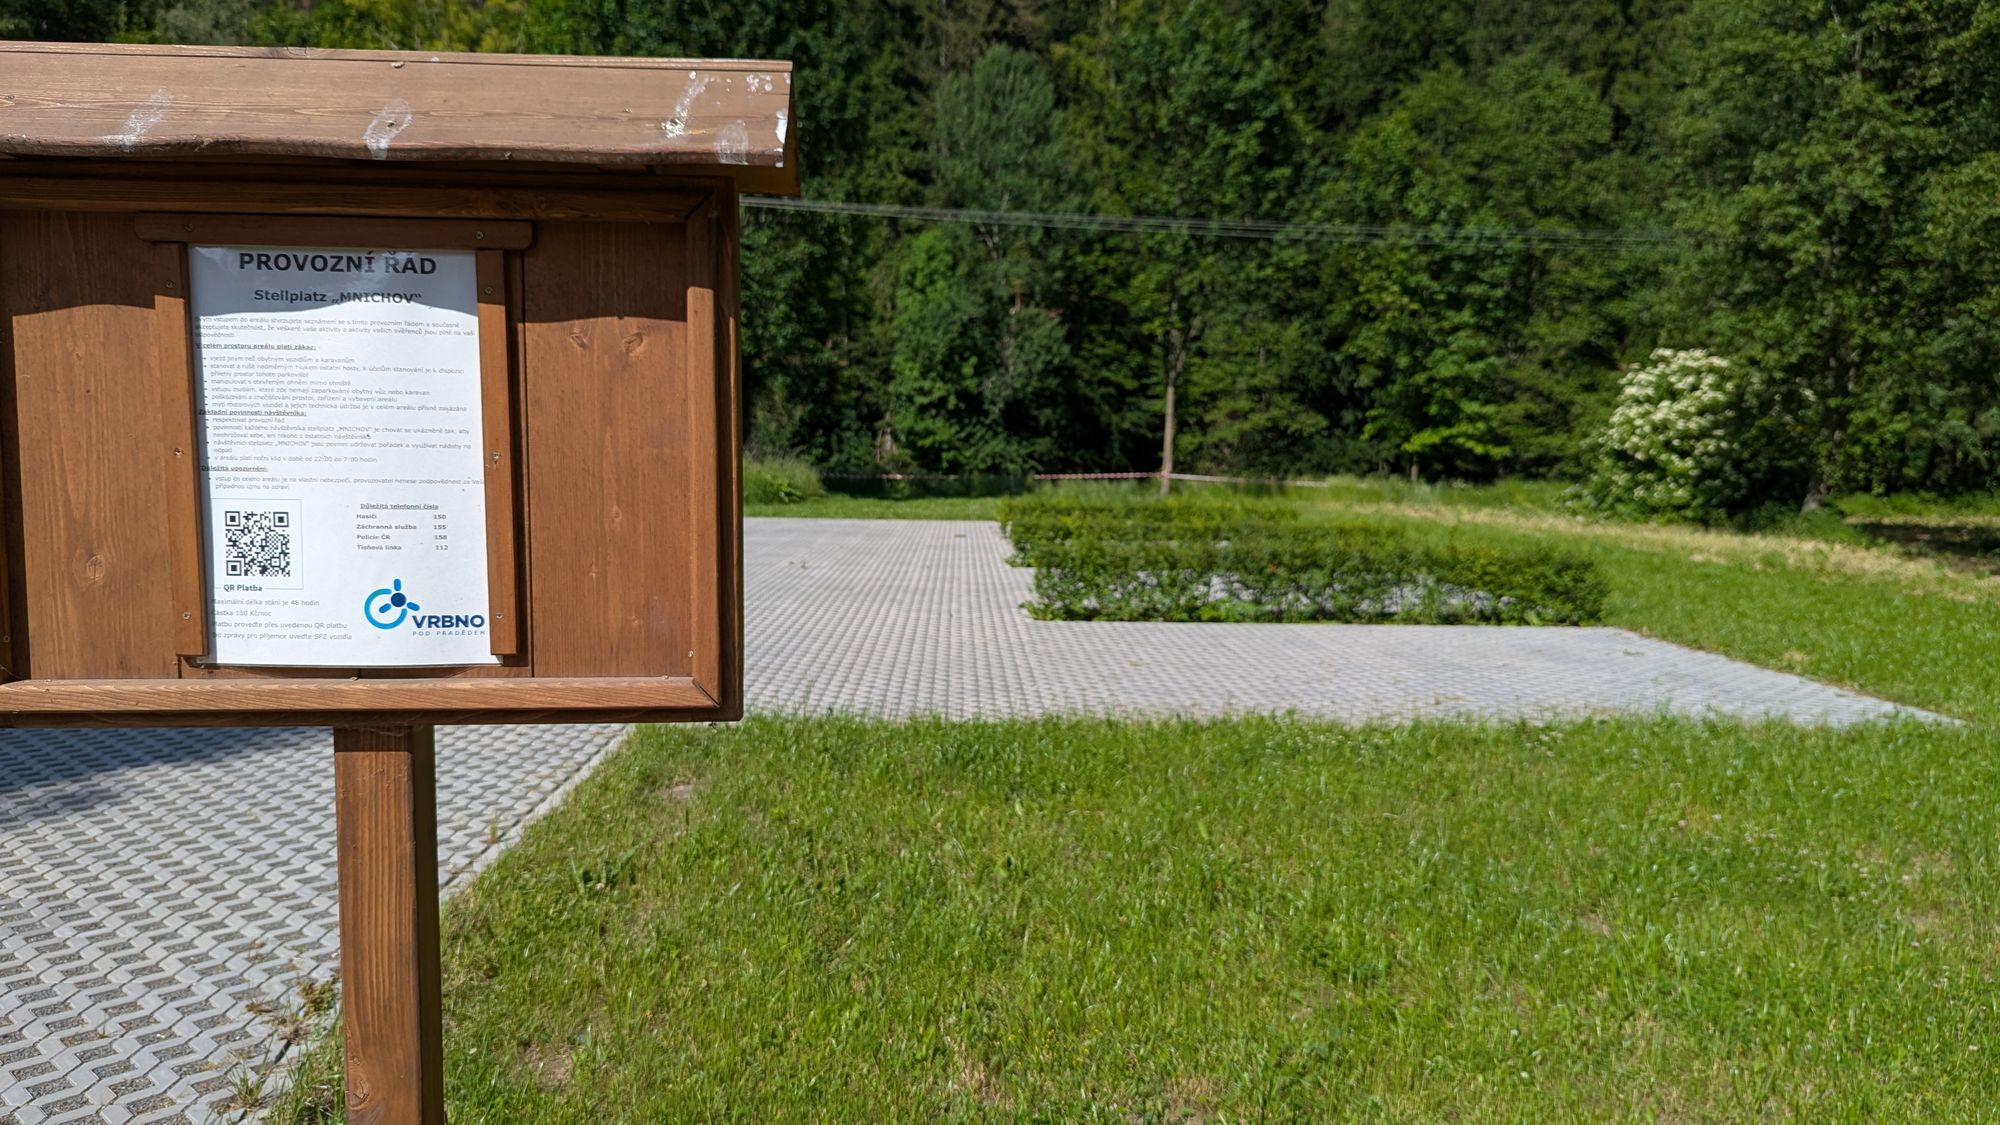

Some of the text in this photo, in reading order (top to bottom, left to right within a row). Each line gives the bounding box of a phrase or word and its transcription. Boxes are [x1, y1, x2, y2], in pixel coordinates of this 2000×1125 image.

[239, 250, 437, 275] PROVOZNÍ ŘÁD
[254, 289, 327, 304] Stellplatz
[412, 614, 485, 628] VRBNO
